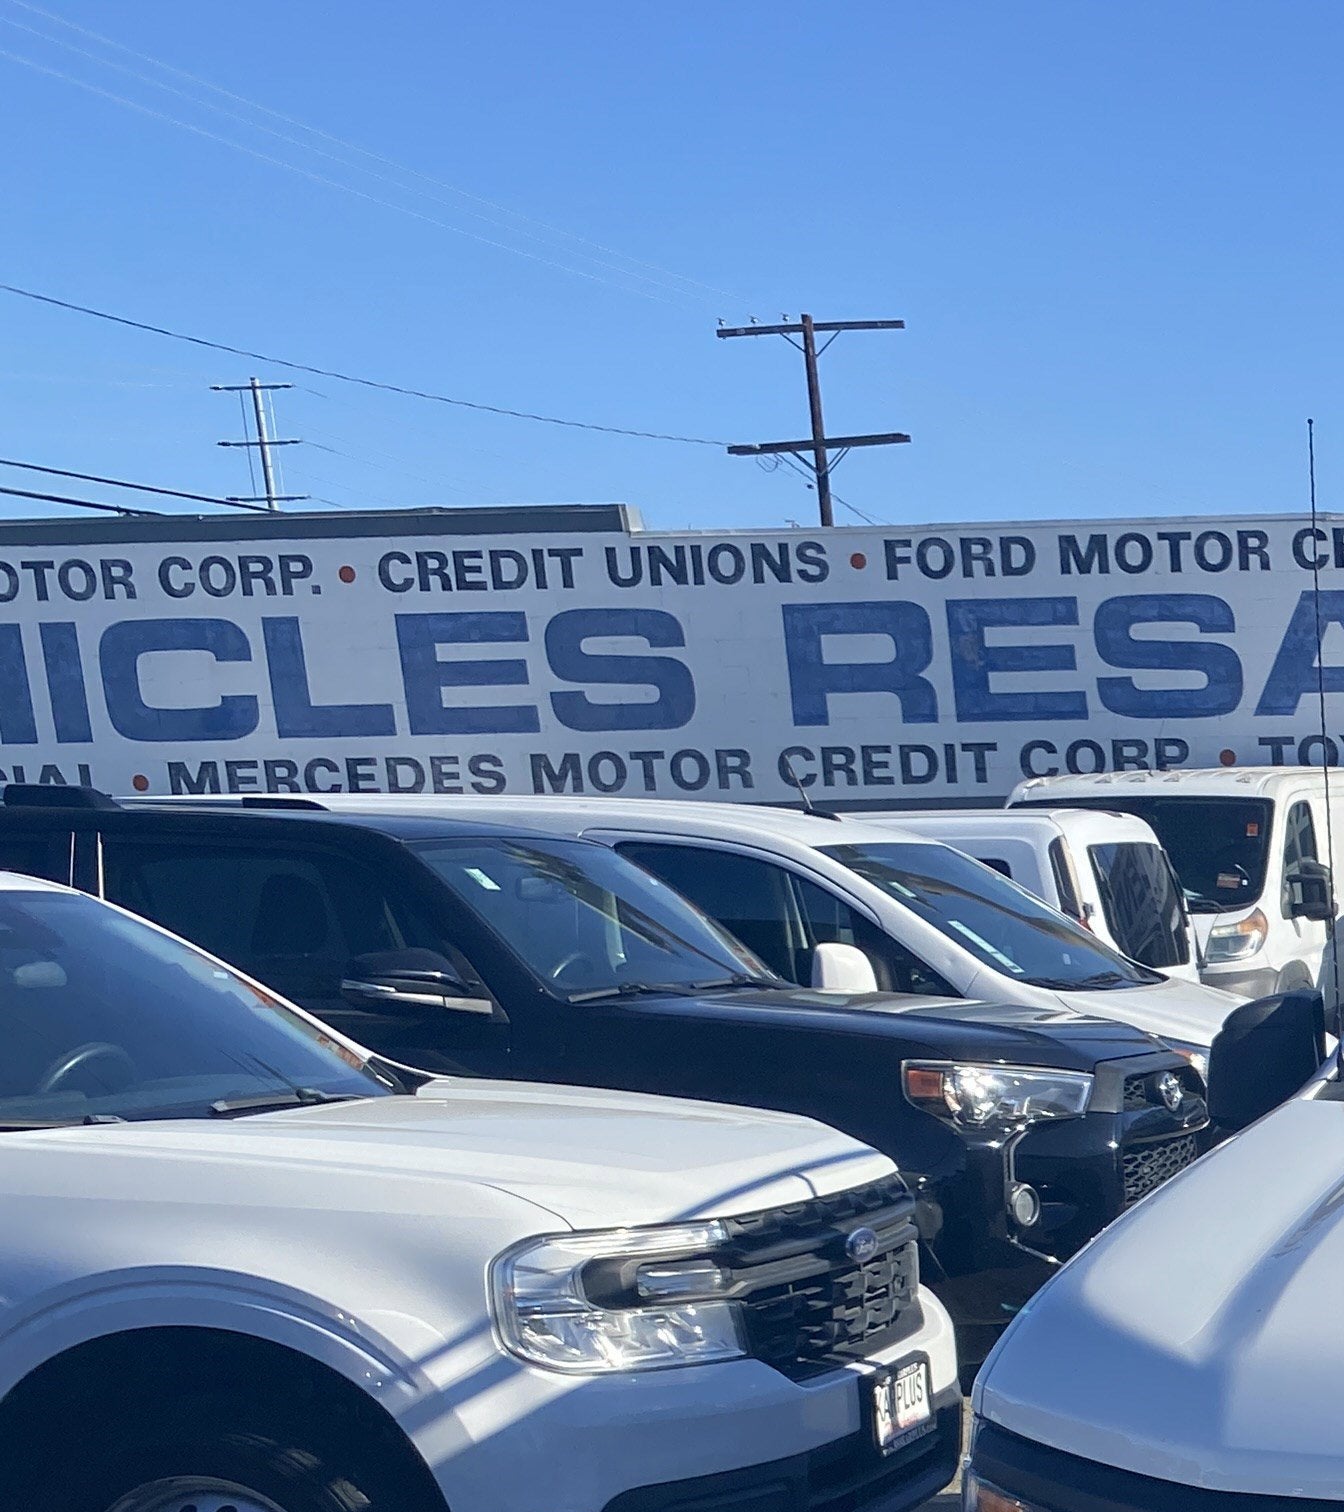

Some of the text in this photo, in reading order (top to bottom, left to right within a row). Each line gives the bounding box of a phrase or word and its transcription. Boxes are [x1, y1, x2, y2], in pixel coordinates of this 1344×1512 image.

[157, 554, 322, 599] CORP.
[377, 547, 584, 593] CREDIT
[604, 540, 830, 588] UNIONS
[882, 535, 1036, 581] FORD
[1057, 529, 1271, 576] MOTOR
[167, 753, 507, 796] MERCEDES
[529, 748, 755, 795] MOTOR
[778, 741, 998, 788] CREDIT
